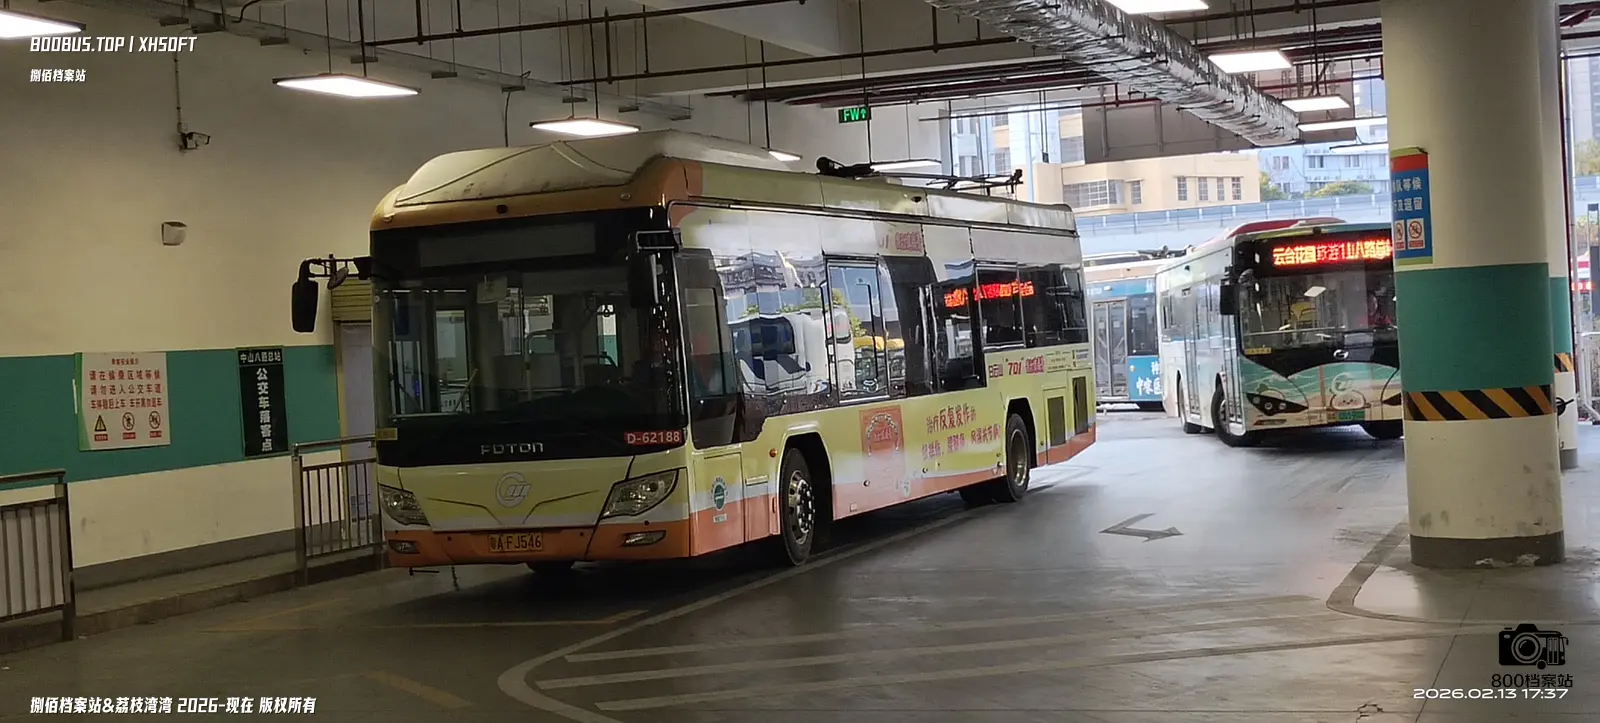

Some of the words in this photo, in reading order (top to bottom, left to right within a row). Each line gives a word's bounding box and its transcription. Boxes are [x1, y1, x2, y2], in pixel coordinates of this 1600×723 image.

[843, 108, 860, 121] FW
[240, 351, 282, 364] 中山八路总站
[90, 383, 163, 396] 请勿进入公交车道
[256, 367, 273, 452] 公交车落客点
[480, 442, 544, 455] FOTON
[626, 430, 680, 444] D-62188
